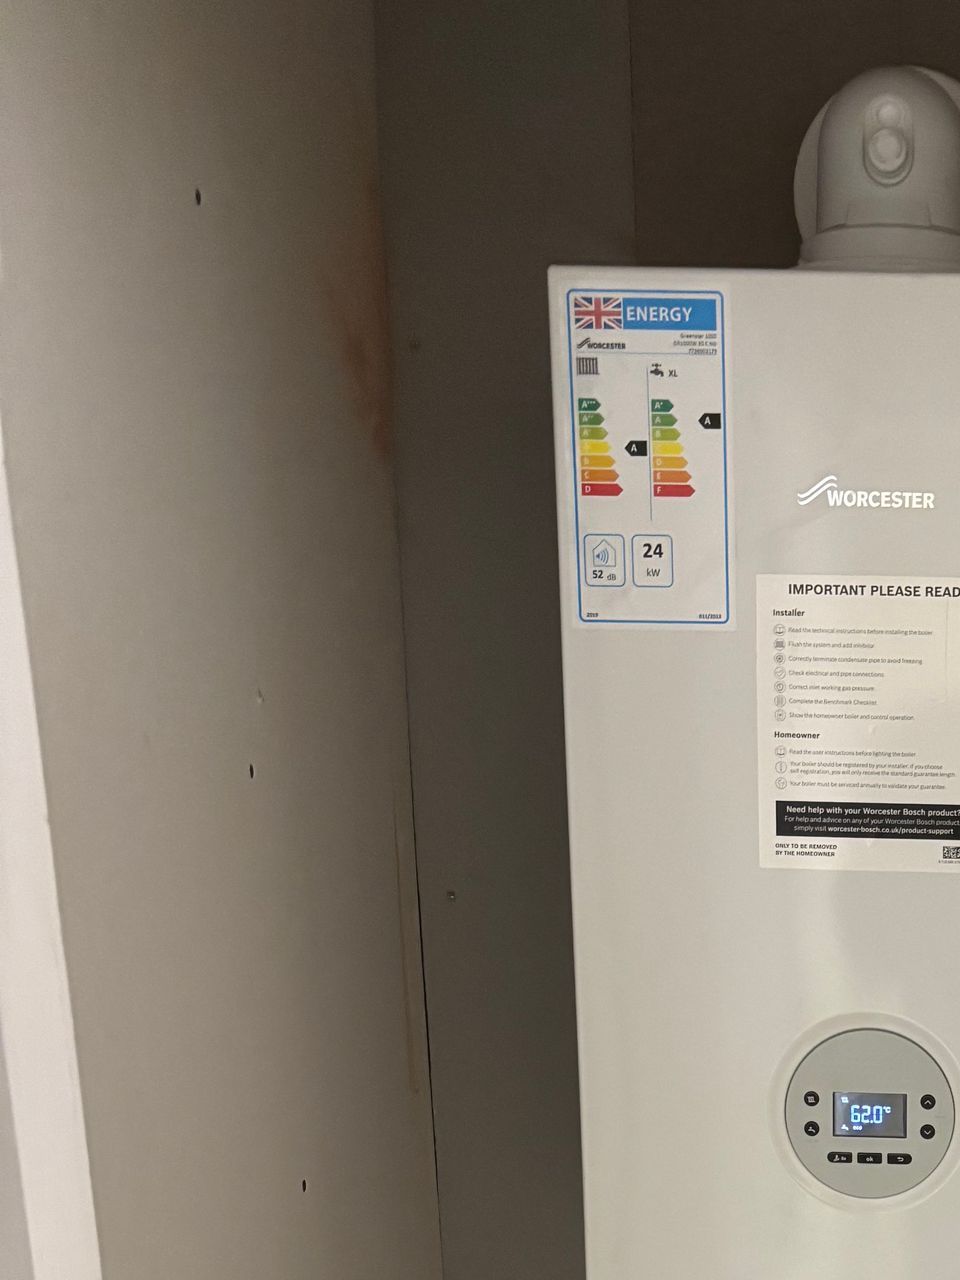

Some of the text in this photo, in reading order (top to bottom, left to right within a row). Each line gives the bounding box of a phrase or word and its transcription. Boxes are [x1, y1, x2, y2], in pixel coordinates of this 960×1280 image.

[626, 306, 693, 322] ENERGY
[587, 342, 626, 350] WORCESTER
[668, 369, 678, 378] XL
[704, 416, 711, 426] A
[630, 444, 638, 453] A
[585, 485, 592, 494] D
[657, 486, 663, 495] F
[826, 489, 935, 509] WORCESTER
[642, 543, 664, 559] 24
[592, 569, 617, 581] 52 dB
[646, 568, 661, 578] kW
[788, 583, 867, 596] IMPORTANT
[870, 584, 922, 597] PLEASE
[773, 608, 806, 617] Installer
[774, 731, 821, 740] Homeowner
[786, 805, 807, 814] Need
[808, 806, 825, 815] help
[826, 806, 843, 814] with
[844, 808, 861, 816] your
[863, 807, 901, 816] Worcester
[903, 808, 926, 816] Bosch
[784, 815, 795, 823] For
[795, 815, 810, 824] help
[823, 816, 841, 824] advice
[916, 818, 935, 826] Bosch
[794, 825, 813, 833] simply
